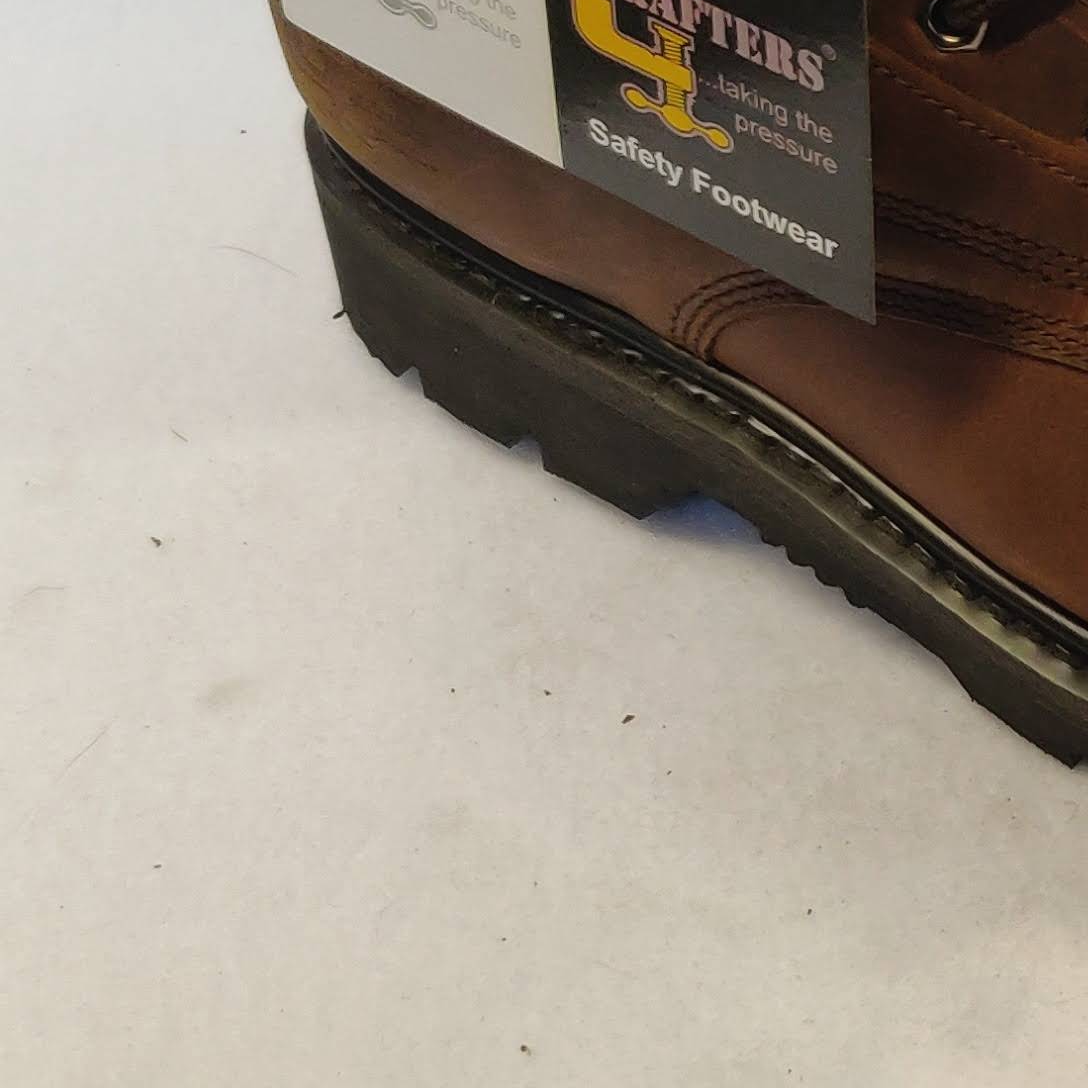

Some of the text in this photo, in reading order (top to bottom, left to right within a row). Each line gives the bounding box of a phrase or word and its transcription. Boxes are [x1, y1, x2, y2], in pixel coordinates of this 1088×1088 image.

[733, 112, 839, 175] pressure
[796, 109, 834, 145] the
[586, 118, 841, 260] Safety Footwear
